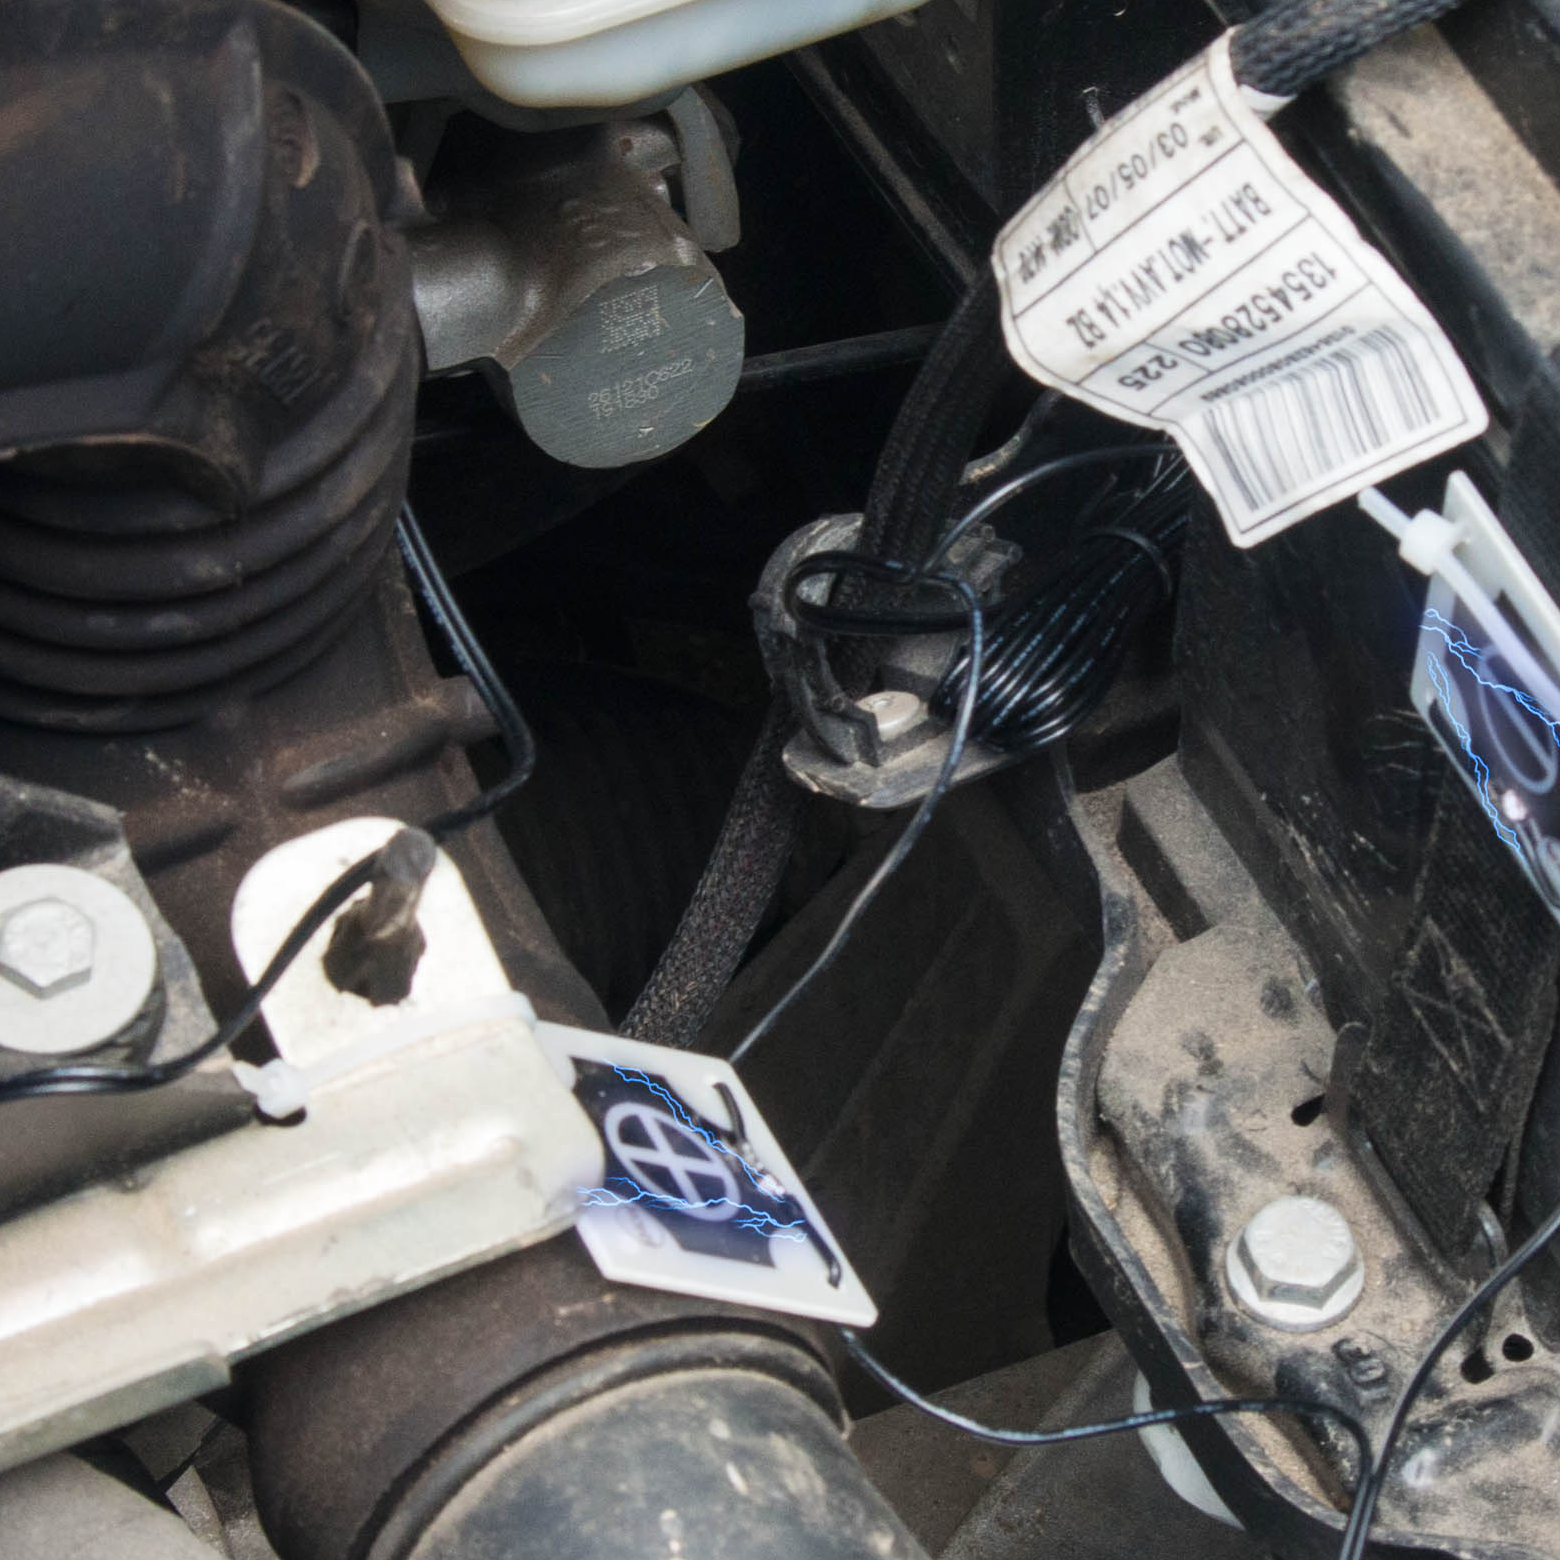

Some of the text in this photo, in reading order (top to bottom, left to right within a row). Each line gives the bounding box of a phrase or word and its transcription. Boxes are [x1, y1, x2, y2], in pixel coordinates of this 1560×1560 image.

[1088, 122, 1189, 221] 03/05/07
[1065, 307, 1106, 349] BZ
[1117, 353, 1179, 391] 225
